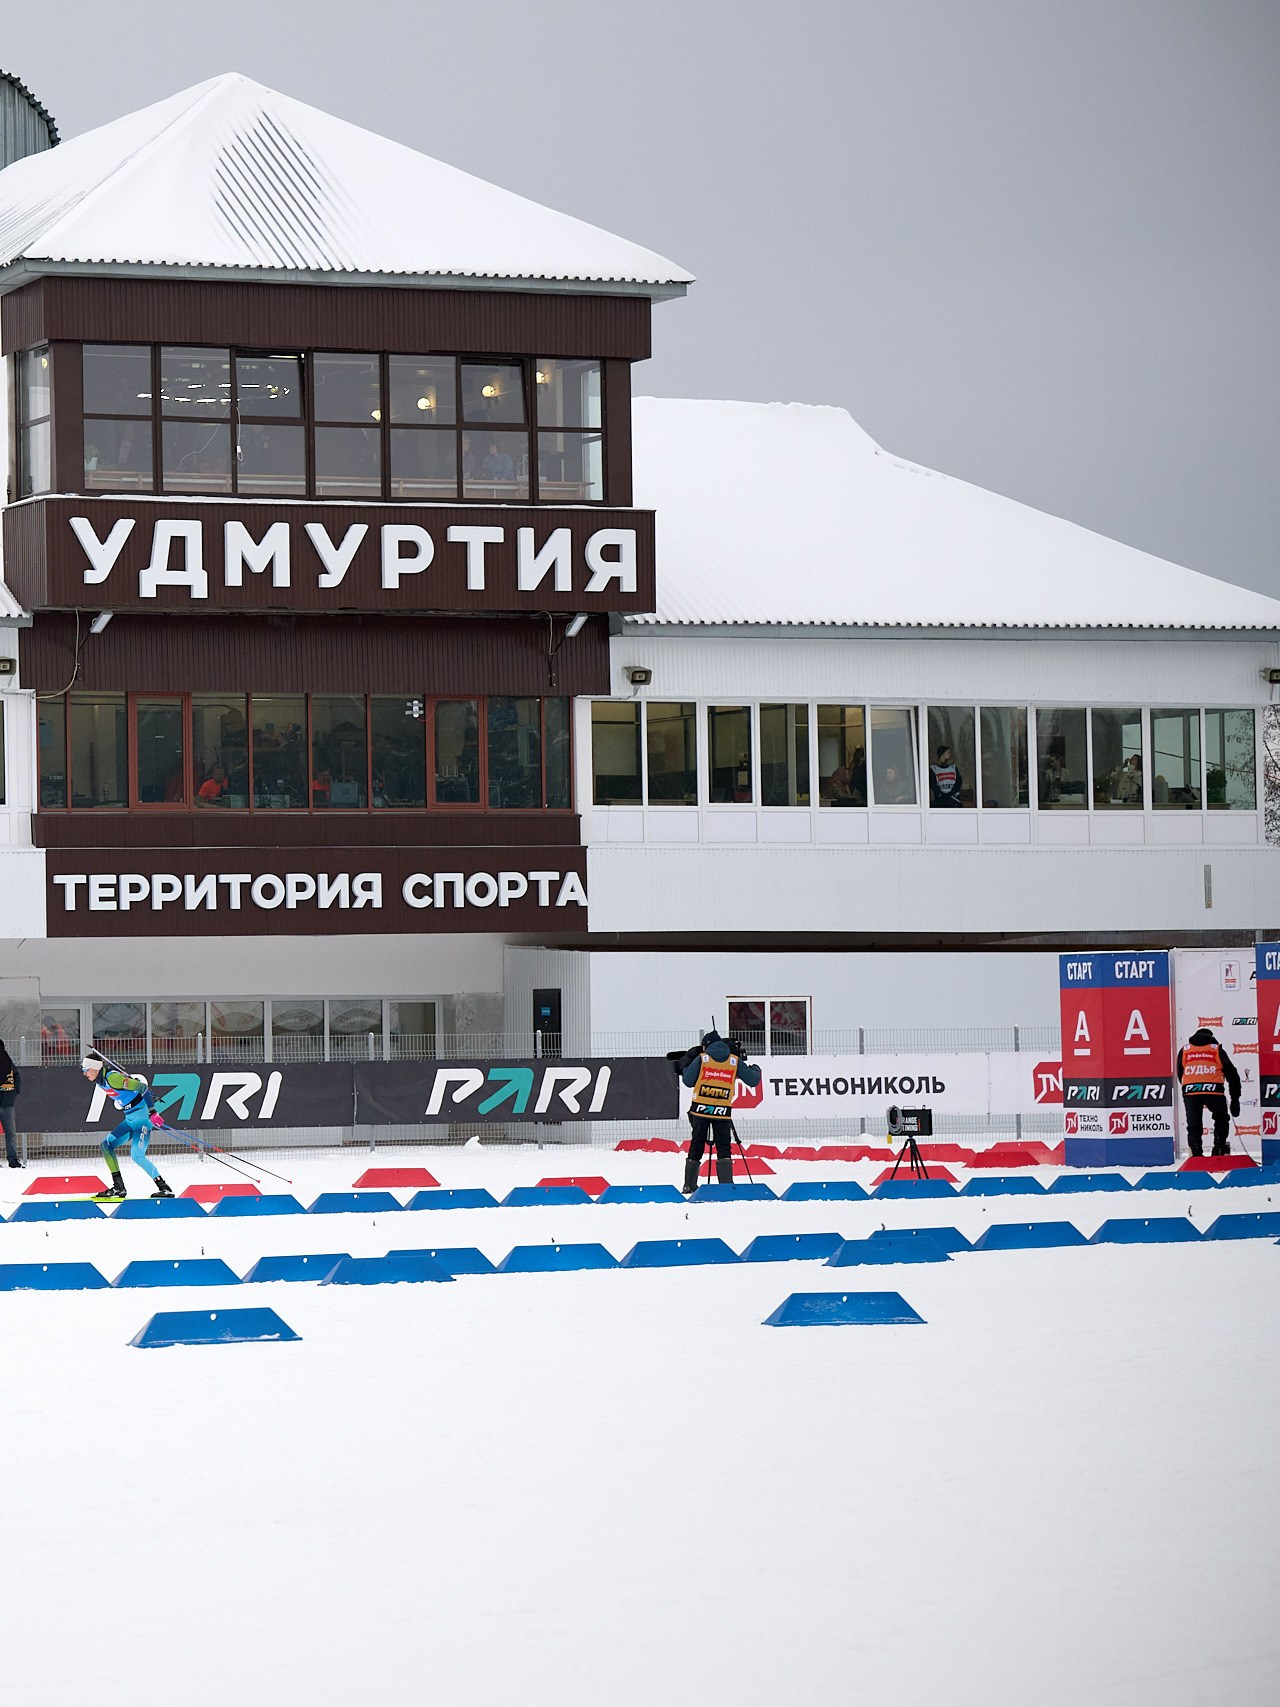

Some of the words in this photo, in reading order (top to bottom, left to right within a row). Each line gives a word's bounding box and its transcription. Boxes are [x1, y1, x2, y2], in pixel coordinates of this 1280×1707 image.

[69, 516, 637, 599] УДМУРТИЯ
[53, 873, 383, 911] ТЕРРИТОРИЯ
[403, 871, 588, 908] СПОРТА
[1067, 962, 1092, 980] СТАРТ
[1115, 961, 1155, 979] СТАРТ
[1184, 1064, 1217, 1076] СУДЬЯ
[424, 1065, 611, 1116] PARI
[769, 1076, 946, 1096] ТЕХНОНИКОЛЬ
[1067, 1086, 1100, 1100] PARI
[1112, 1085, 1165, 1100] PARI
[696, 1104, 727, 1115] PARI
[1079, 1114, 1098, 1123] ТЕХНО
[1130, 1114, 1162, 1122] ТЕХНО
[1080, 1124, 1103, 1132] НИКОЛЬ
[1132, 1123, 1170, 1131] НИКОЛЬ
